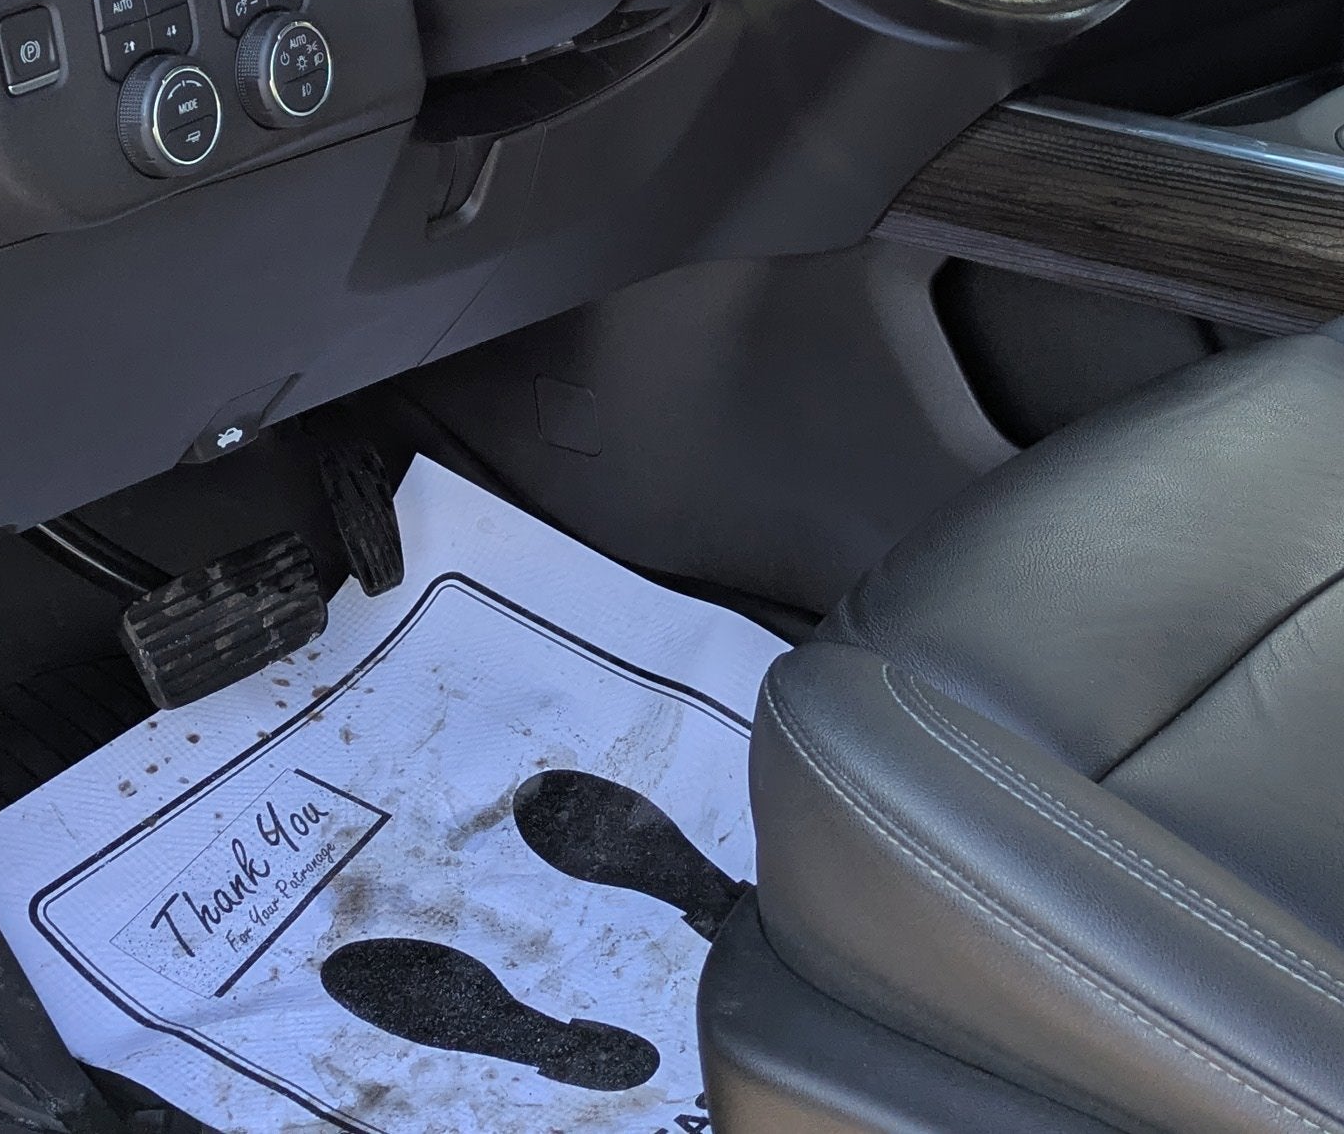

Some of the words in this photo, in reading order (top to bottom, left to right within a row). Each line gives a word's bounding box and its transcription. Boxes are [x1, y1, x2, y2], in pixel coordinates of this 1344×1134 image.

[289, 33, 307, 50] AUTO
[178, 97, 199, 115] MODE
[150, 838, 271, 958] Thank
[256, 801, 330, 852] You
[225, 928, 253, 954] For
[248, 897, 281, 927] Your
[275, 842, 336, 900] Patronage
